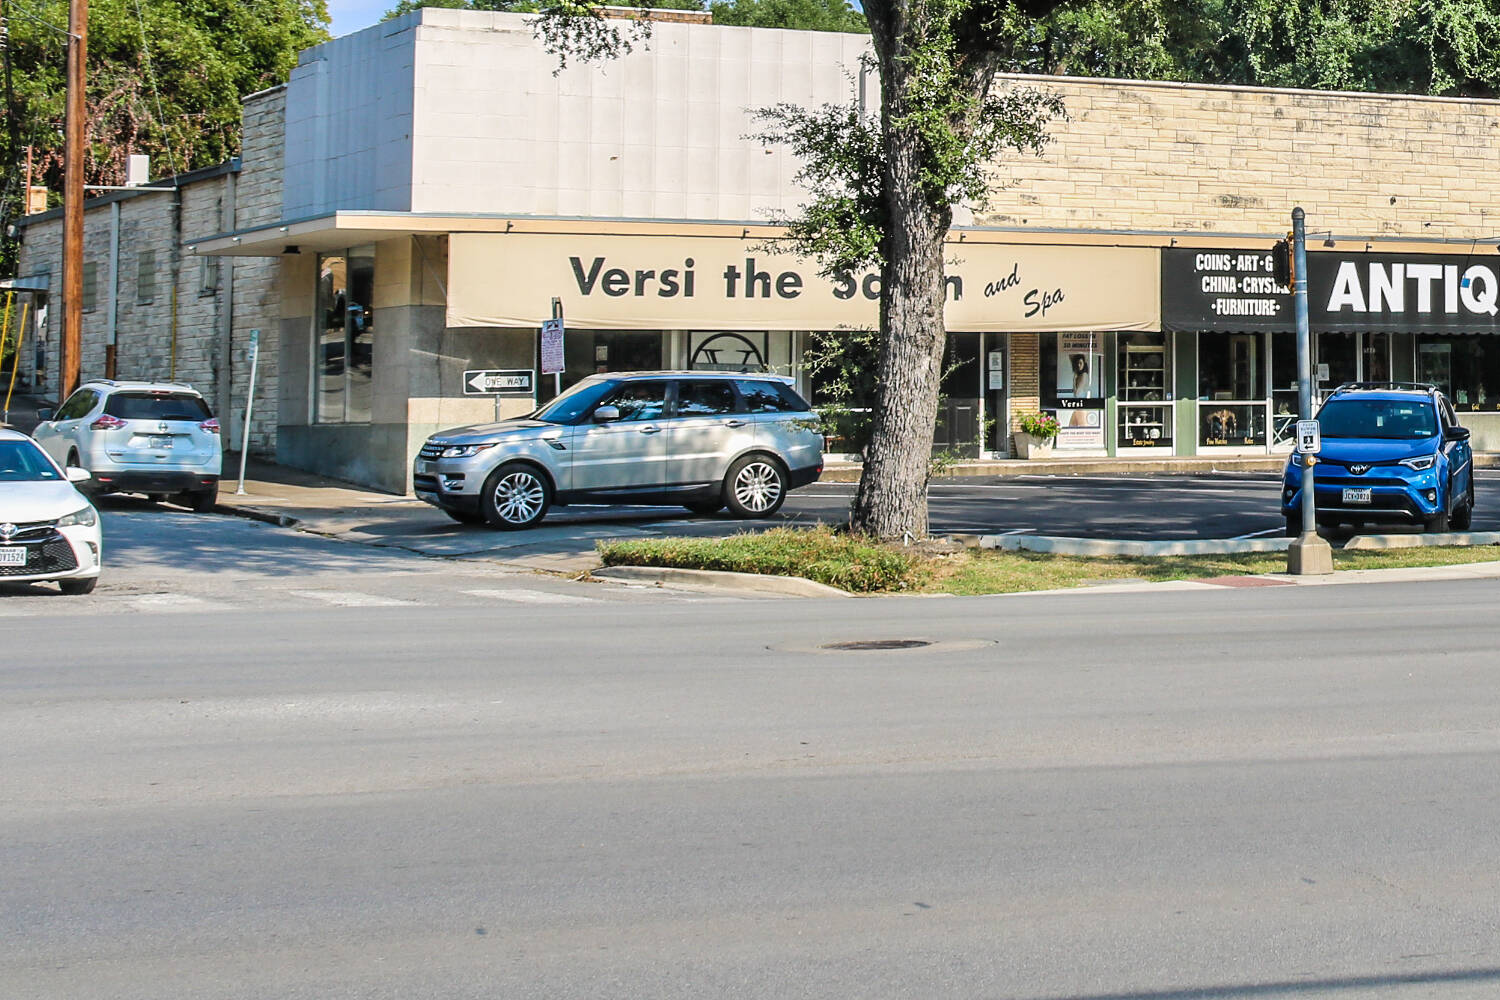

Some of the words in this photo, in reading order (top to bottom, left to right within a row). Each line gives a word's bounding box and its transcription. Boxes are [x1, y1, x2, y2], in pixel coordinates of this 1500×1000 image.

[569, 256, 695, 298] Versi
[723, 257, 803, 300] the
[831, 268, 963, 302] San
[984, 263, 1021, 298] and
[1023, 287, 1065, 318] Spa
[485, 376, 501, 387] ONE
[507, 376, 525, 386] WAY
[1061, 399, 1084, 408] Versi
